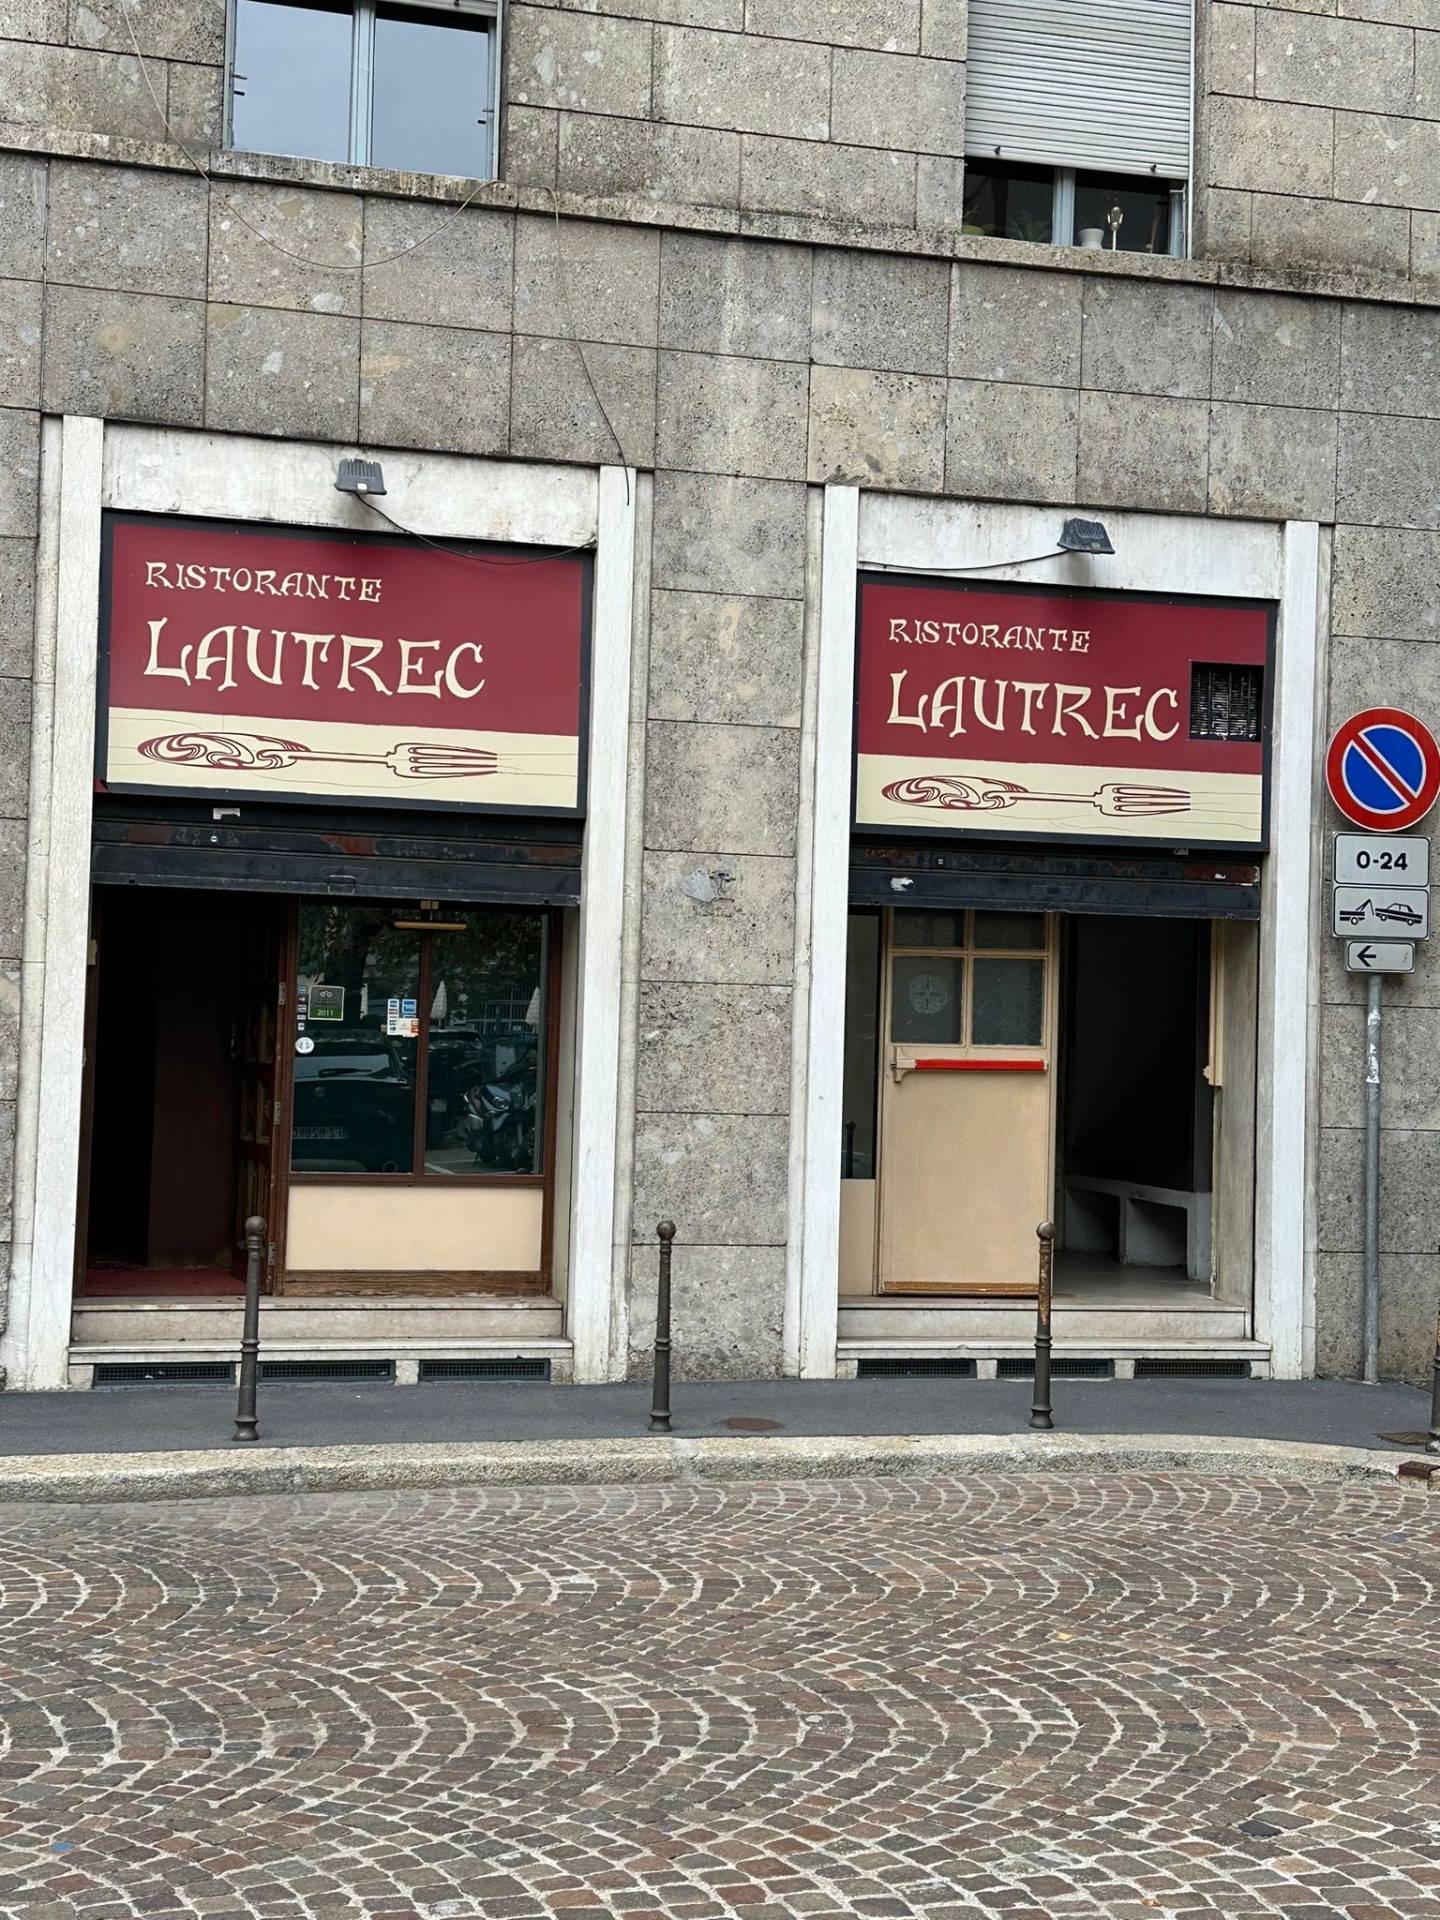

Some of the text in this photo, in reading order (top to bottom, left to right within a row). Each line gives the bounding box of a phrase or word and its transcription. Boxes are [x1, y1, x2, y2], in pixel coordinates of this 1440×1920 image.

[145, 561, 382, 603] RISTORANTE
[888, 618, 1090, 653] RISTORANTE
[143, 616, 486, 700] LAUTREC
[886, 669, 1180, 742] LAUTREC
[1356, 850, 1408, 871] 0-24
[317, 1008, 335, 1017] 2011
